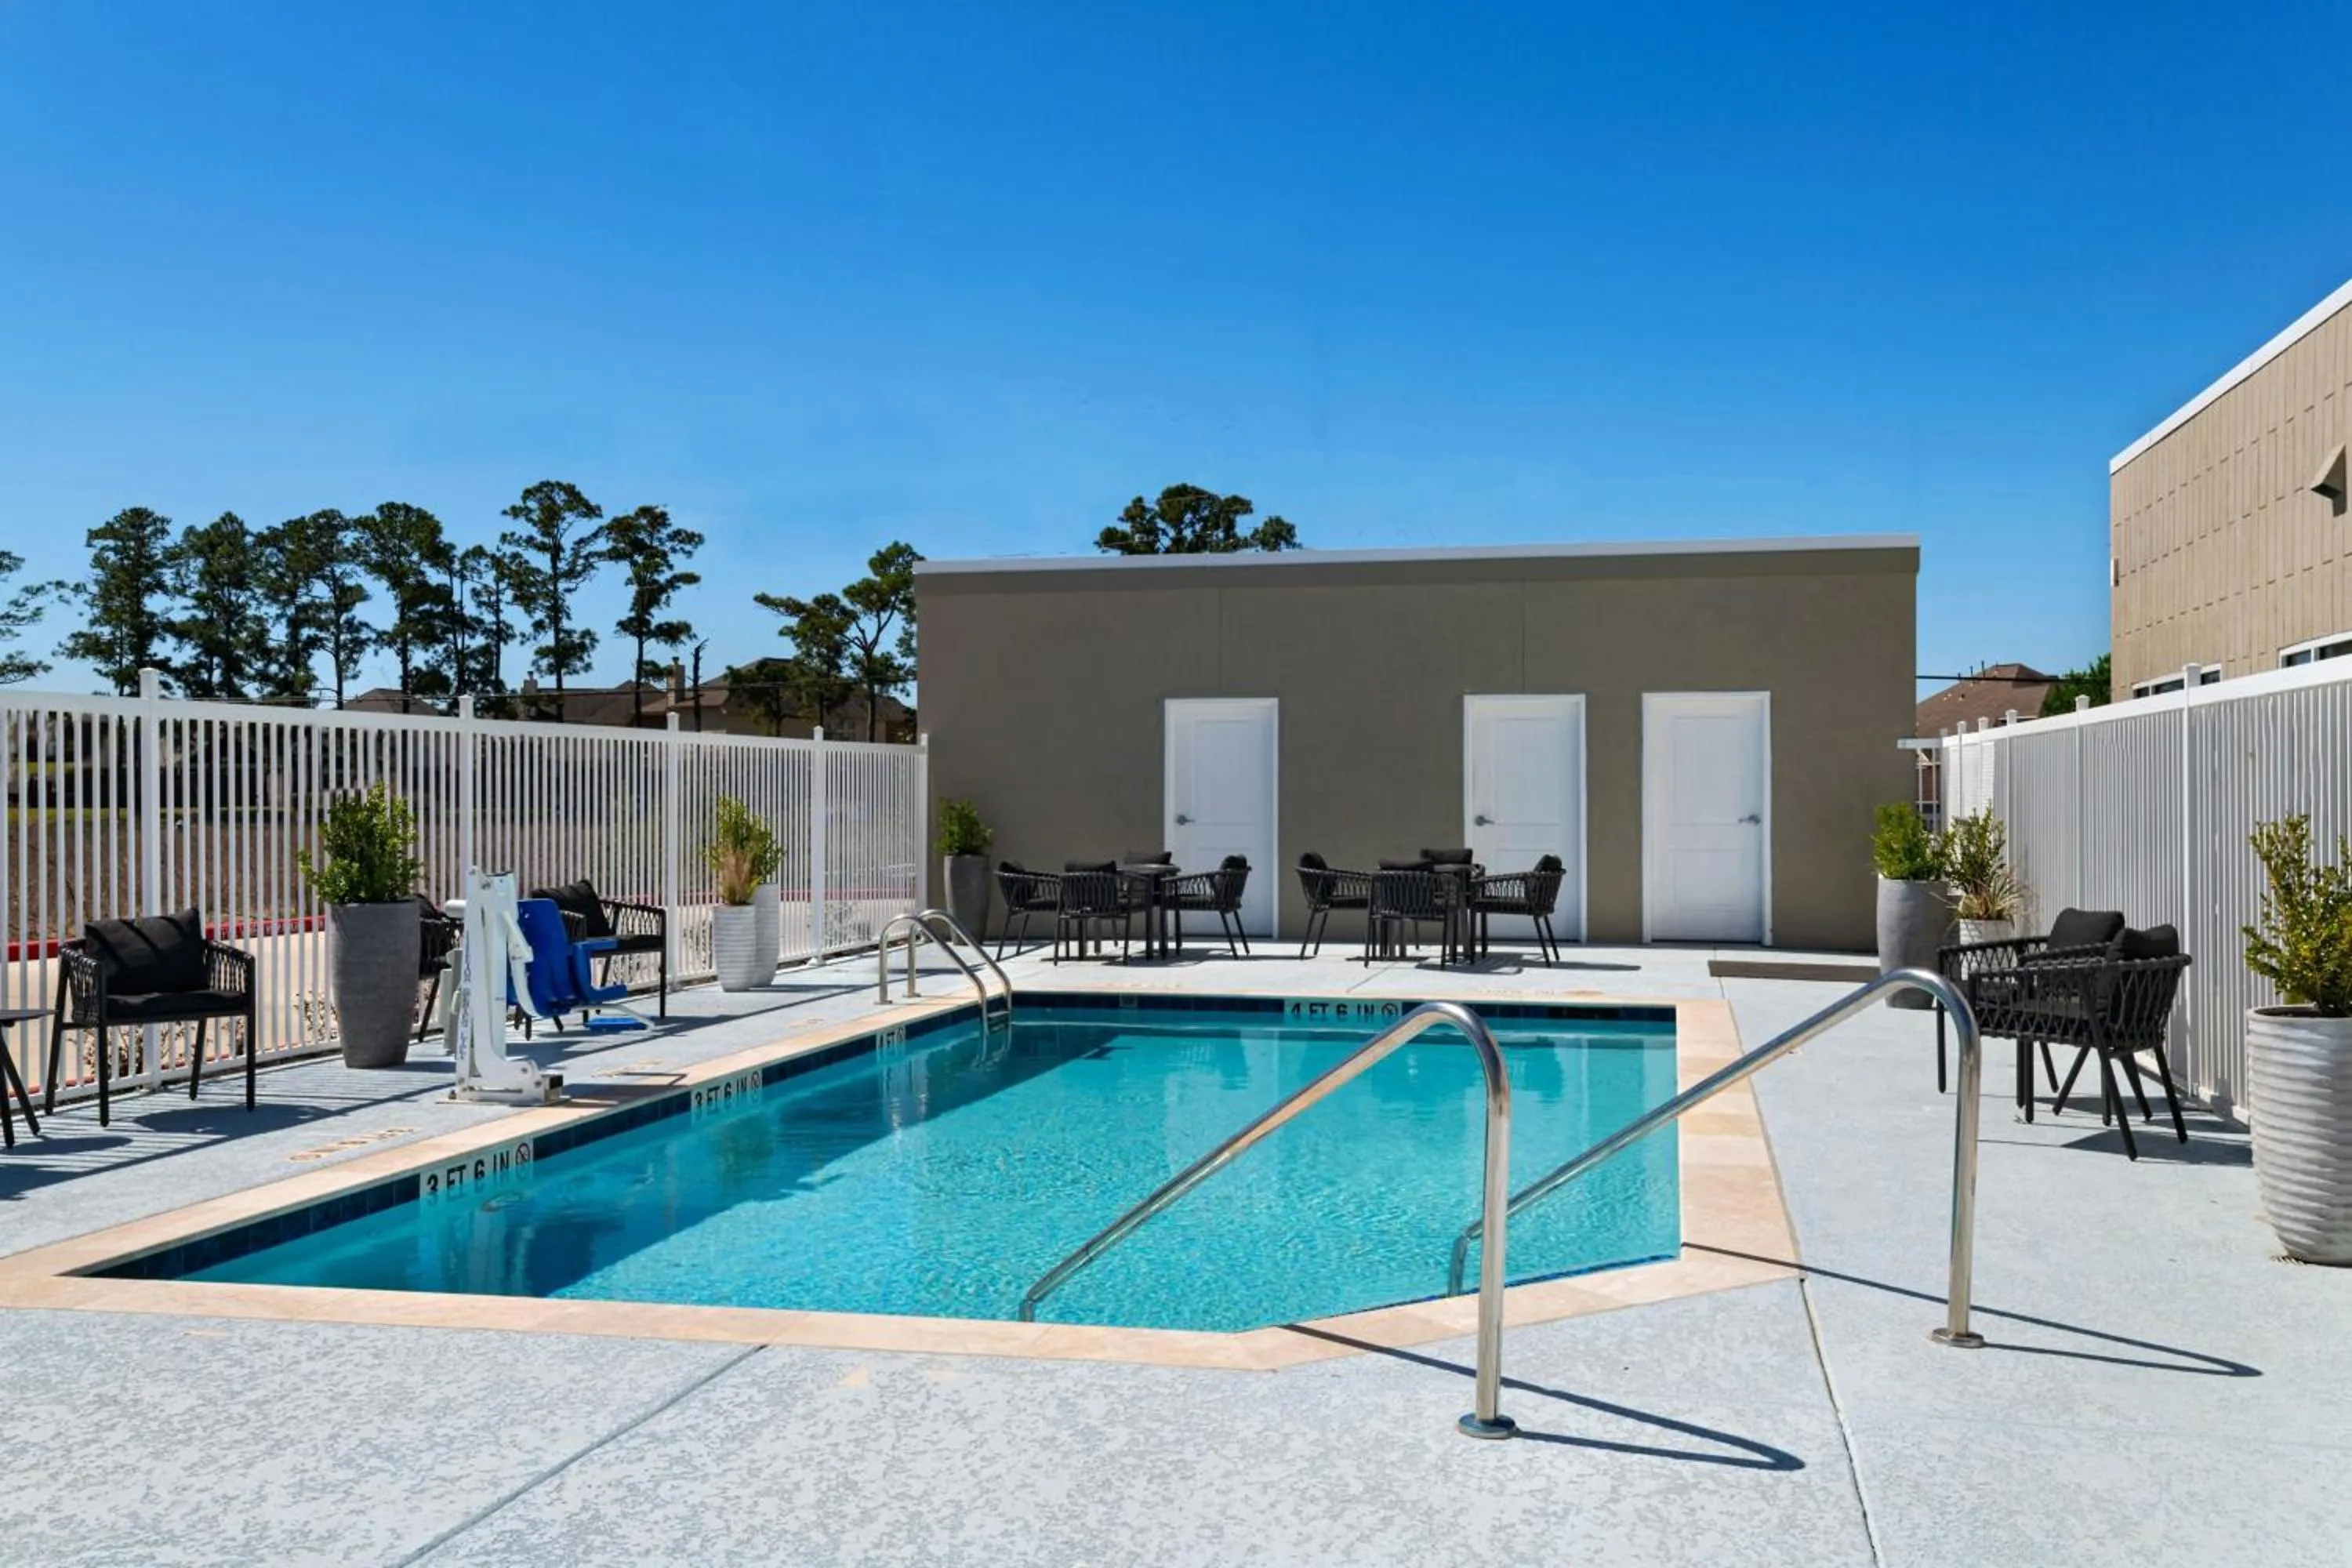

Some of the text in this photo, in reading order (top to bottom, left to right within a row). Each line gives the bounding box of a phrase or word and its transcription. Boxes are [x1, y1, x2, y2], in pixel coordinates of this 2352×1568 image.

[1291, 1003, 1374, 1017] 4 FT 6 IN
[706, 1087, 720, 1104] FT
[724, 1081, 731, 1099] 6
[736, 1076, 747, 1093] IN
[427, 1150, 510, 1192] 3 FT 6 IN
